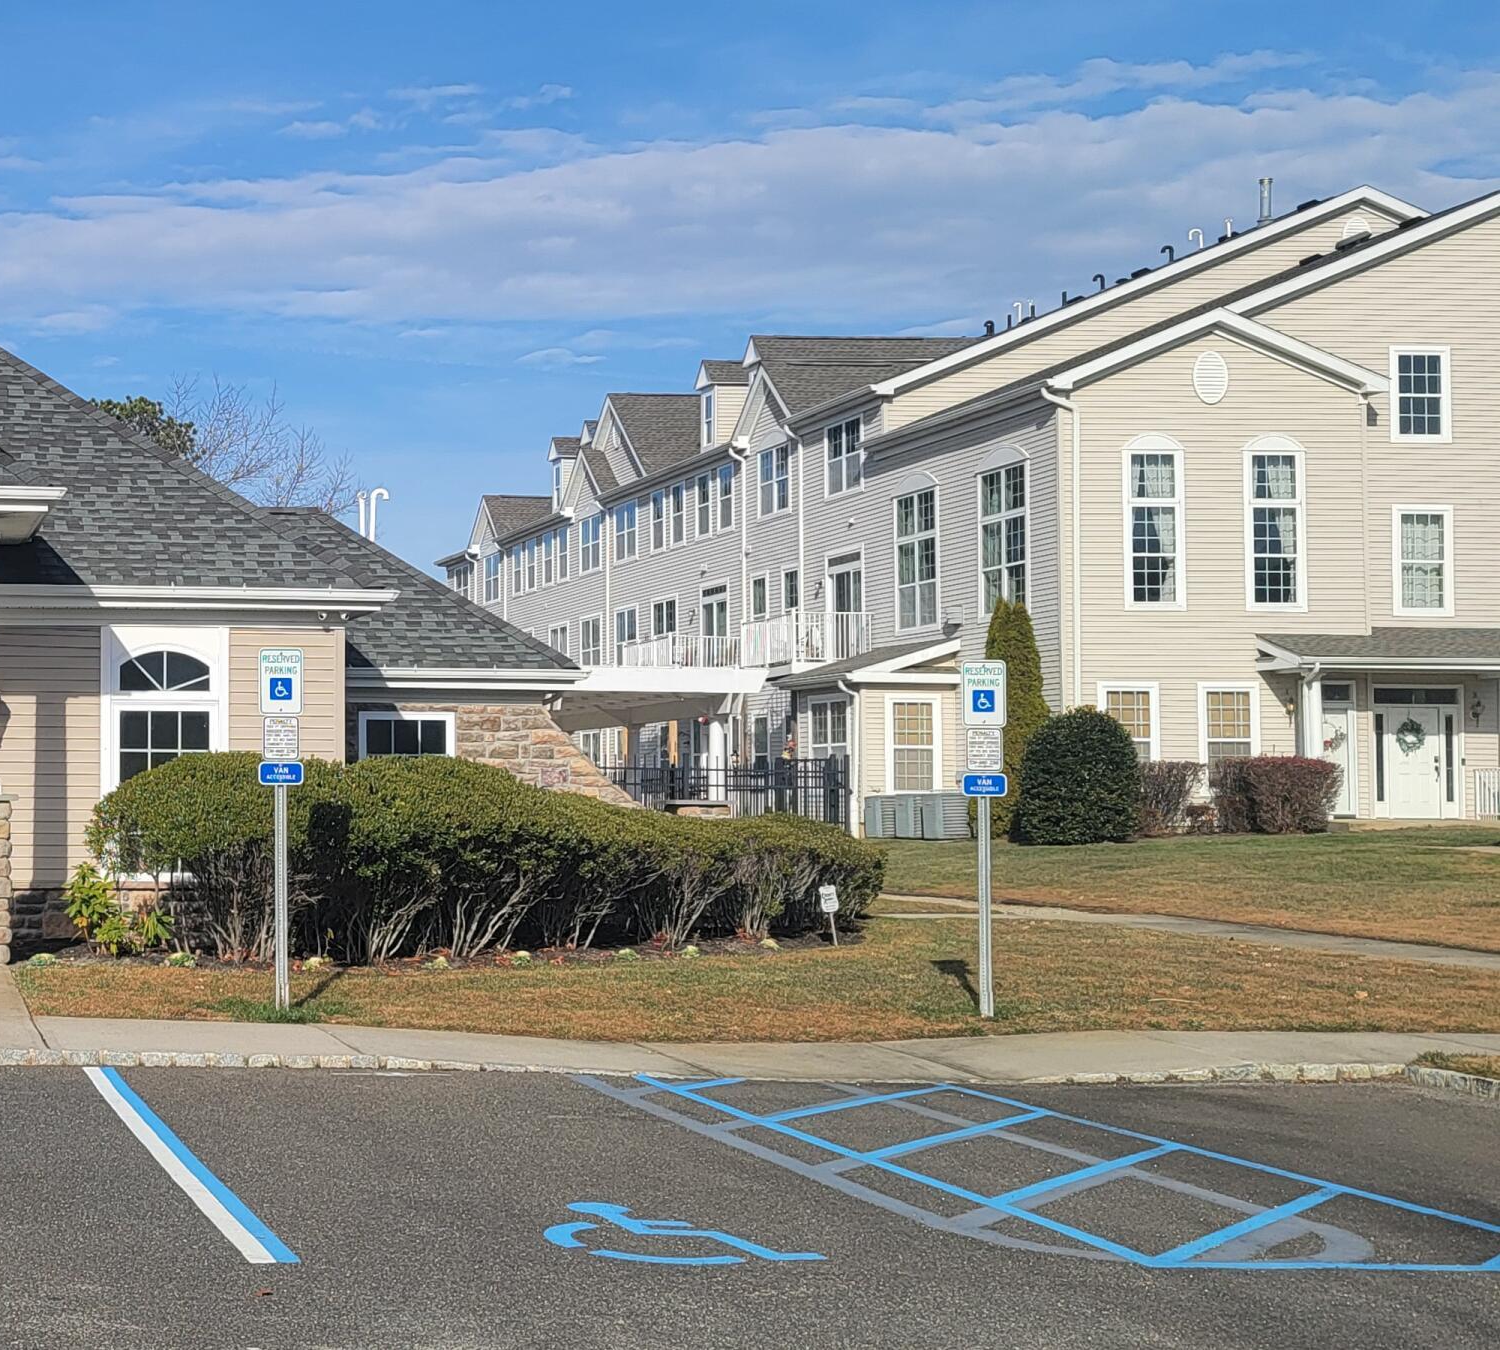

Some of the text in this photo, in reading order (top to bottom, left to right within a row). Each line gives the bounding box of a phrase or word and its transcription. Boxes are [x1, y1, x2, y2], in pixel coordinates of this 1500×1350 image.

[262, 654, 300, 664] RESERVED
[265, 666, 298, 675] PARKING
[965, 667, 1002, 676] RESERVED
[967, 678, 1000, 687] PARKING
